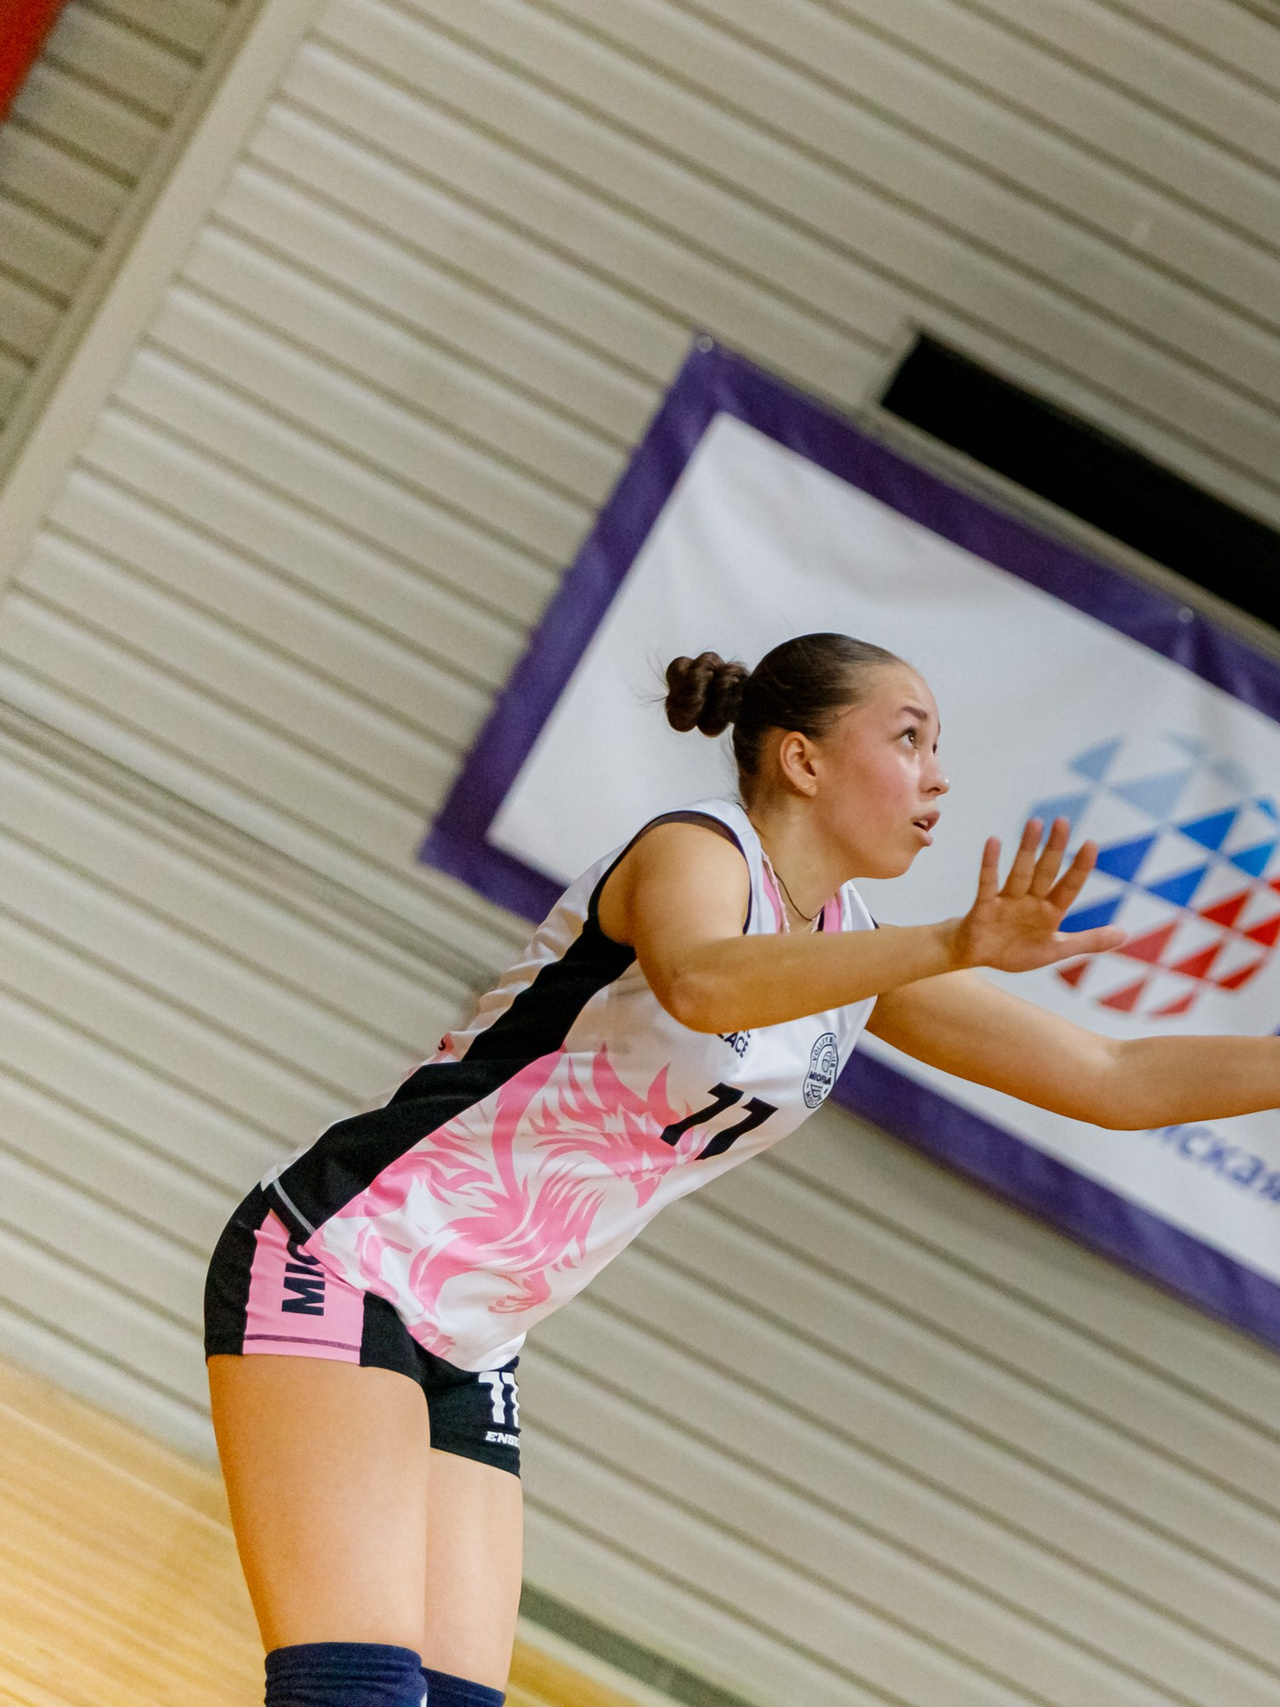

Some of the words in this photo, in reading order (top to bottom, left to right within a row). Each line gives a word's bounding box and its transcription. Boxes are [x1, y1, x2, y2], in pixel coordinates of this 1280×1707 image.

[716, 1031, 749, 1058] ACE
[659, 1081, 780, 1161] 11
[478, 1371, 520, 1428] 11
